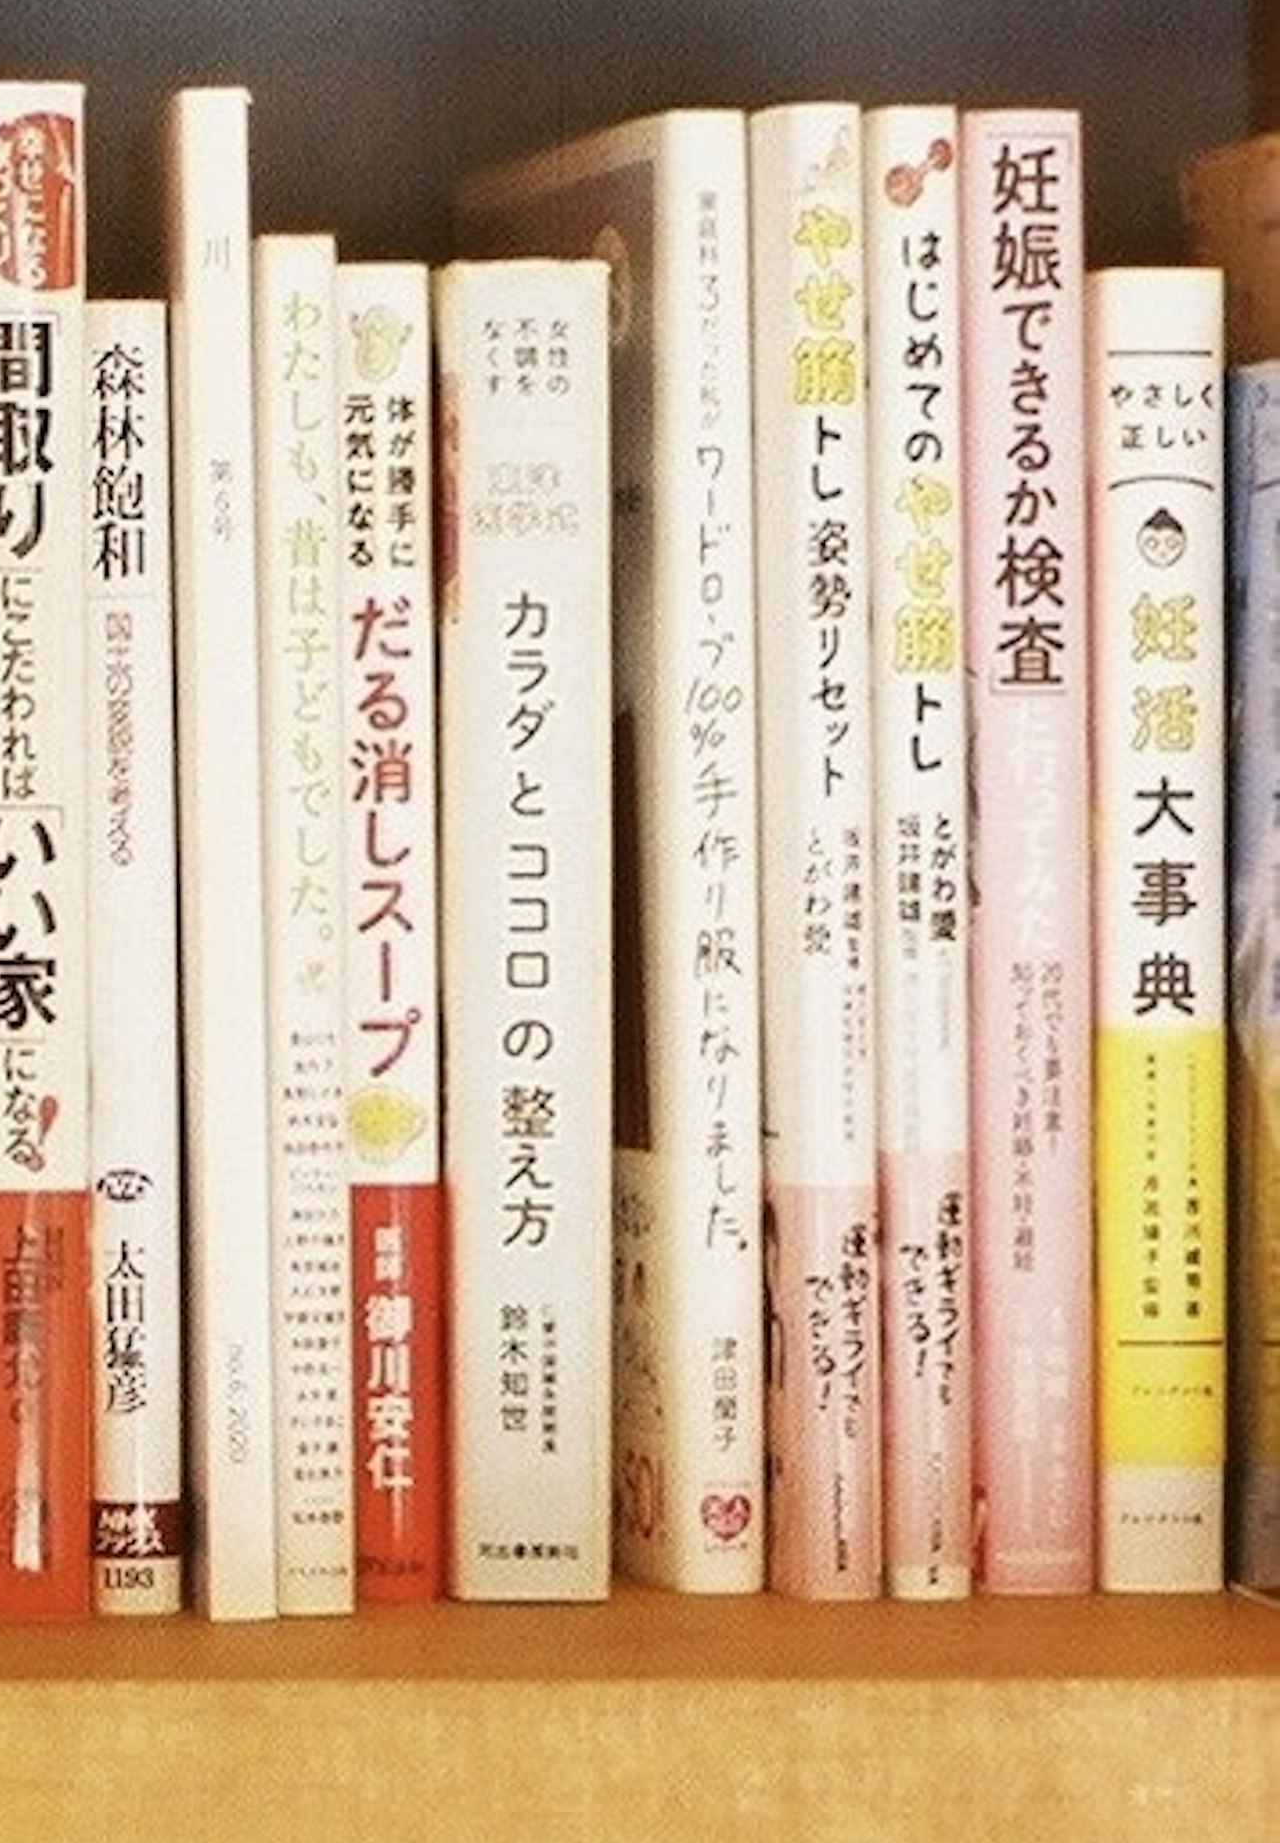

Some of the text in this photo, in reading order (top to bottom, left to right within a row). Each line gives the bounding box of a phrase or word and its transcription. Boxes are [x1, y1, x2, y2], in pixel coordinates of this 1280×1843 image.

[484, 317, 504, 397] なくす
[514, 317, 538, 396] 不調を
[545, 317, 571, 397] 女性の
[1107, 381, 1216, 409] やさしく
[1119, 422, 1210, 450] 正しい
[91, 342, 146, 583] 森林飽和
[344, 392, 377, 570] 元気になる
[385, 395, 417, 570] 体が勝手に
[792, 207, 857, 798] やせ筋トレ姿勢リセット
[891, 231, 956, 774] はじめてのやせ筋トレ
[350, 596, 422, 1081] だる消しスープ
[929, 814, 958, 943] とがわ愛
[1128, 590, 1199, 1020] 妊活大事典
[502, 589, 556, 1250] カラダとココロの整え方
[105, 1238, 150, 1419] 太田猛彦
[364, 1293, 415, 1491] 御川安仁
[499, 1302, 531, 1433] 鈴木知世
[101, 1565, 156, 1591] 1193
